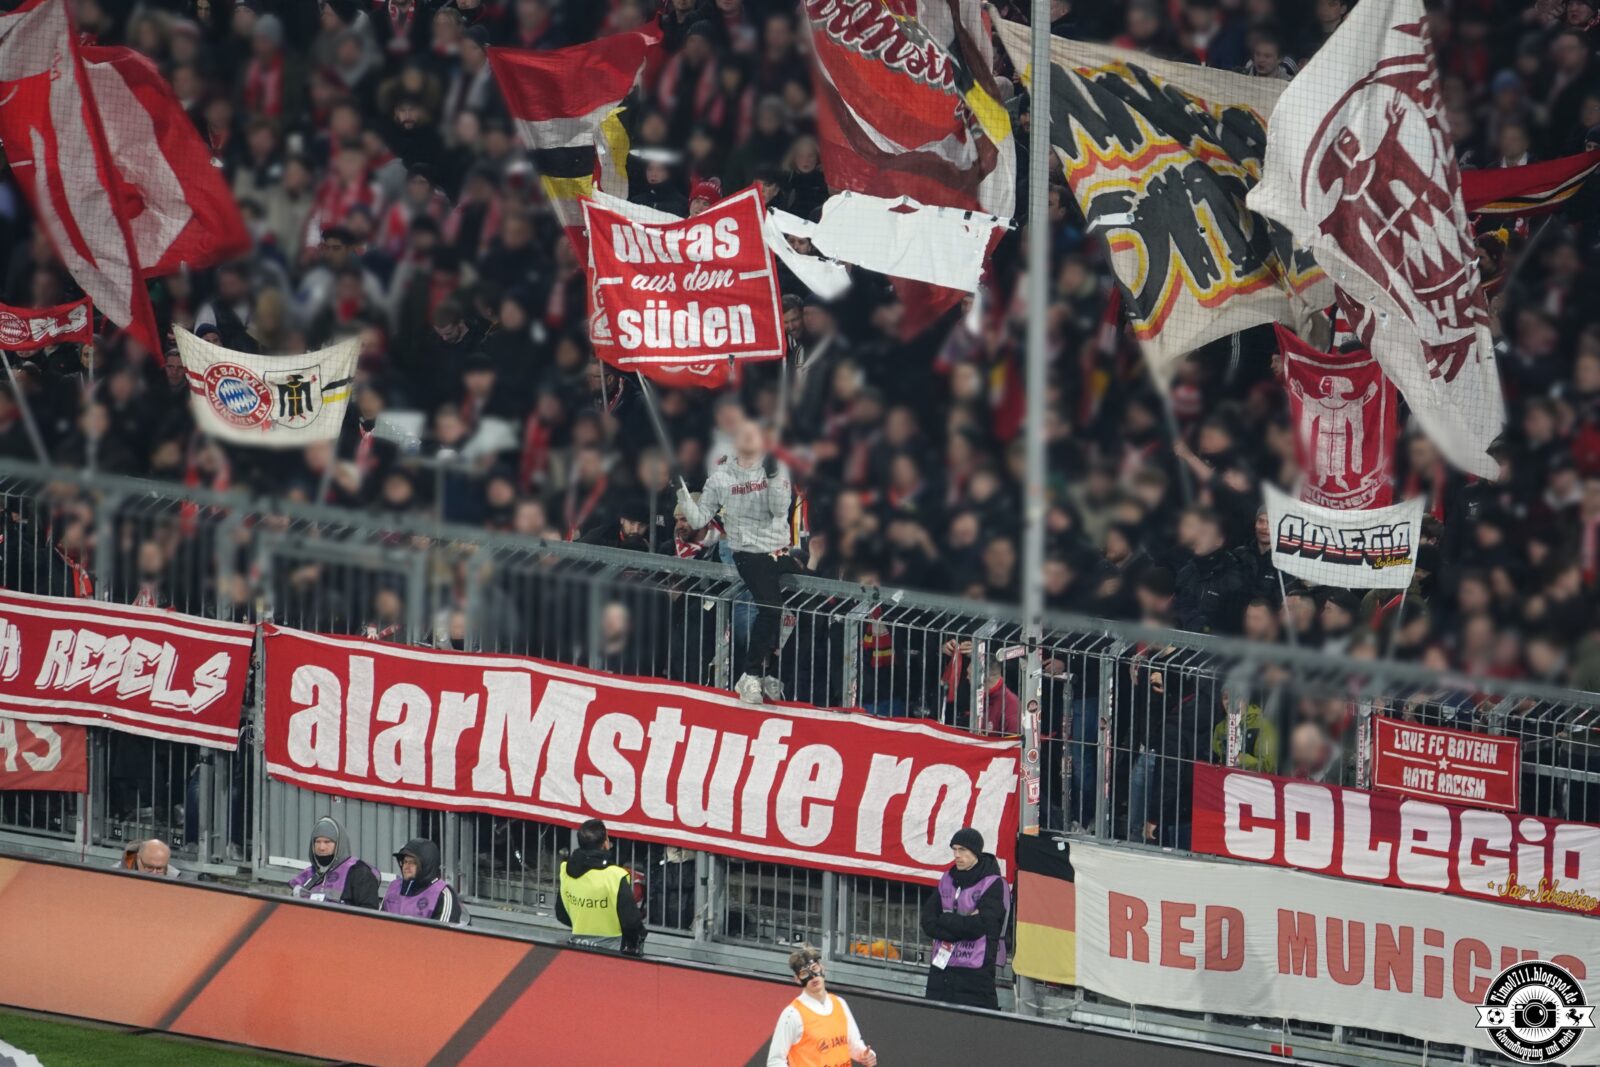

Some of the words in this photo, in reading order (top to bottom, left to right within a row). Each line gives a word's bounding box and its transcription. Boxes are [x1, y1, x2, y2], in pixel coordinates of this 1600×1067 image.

[611, 216, 740, 264] ultras
[631, 272, 677, 293] aus
[683, 263, 735, 291] dem
[617, 299, 756, 350] süden
[35, 628, 231, 714] REBELS
[287, 655, 843, 847] alarMstufe
[855, 753, 1018, 878] rot
[1394, 729, 1425, 753] LOVE
[1428, 734, 1445, 756] FC
[1448, 736, 1498, 764] BAYERN
[1403, 766, 1435, 791] HATE
[1437, 773, 1486, 799] RACISM
[1108, 890, 1245, 972] RED
[1277, 908, 1587, 1005] MUNiC
